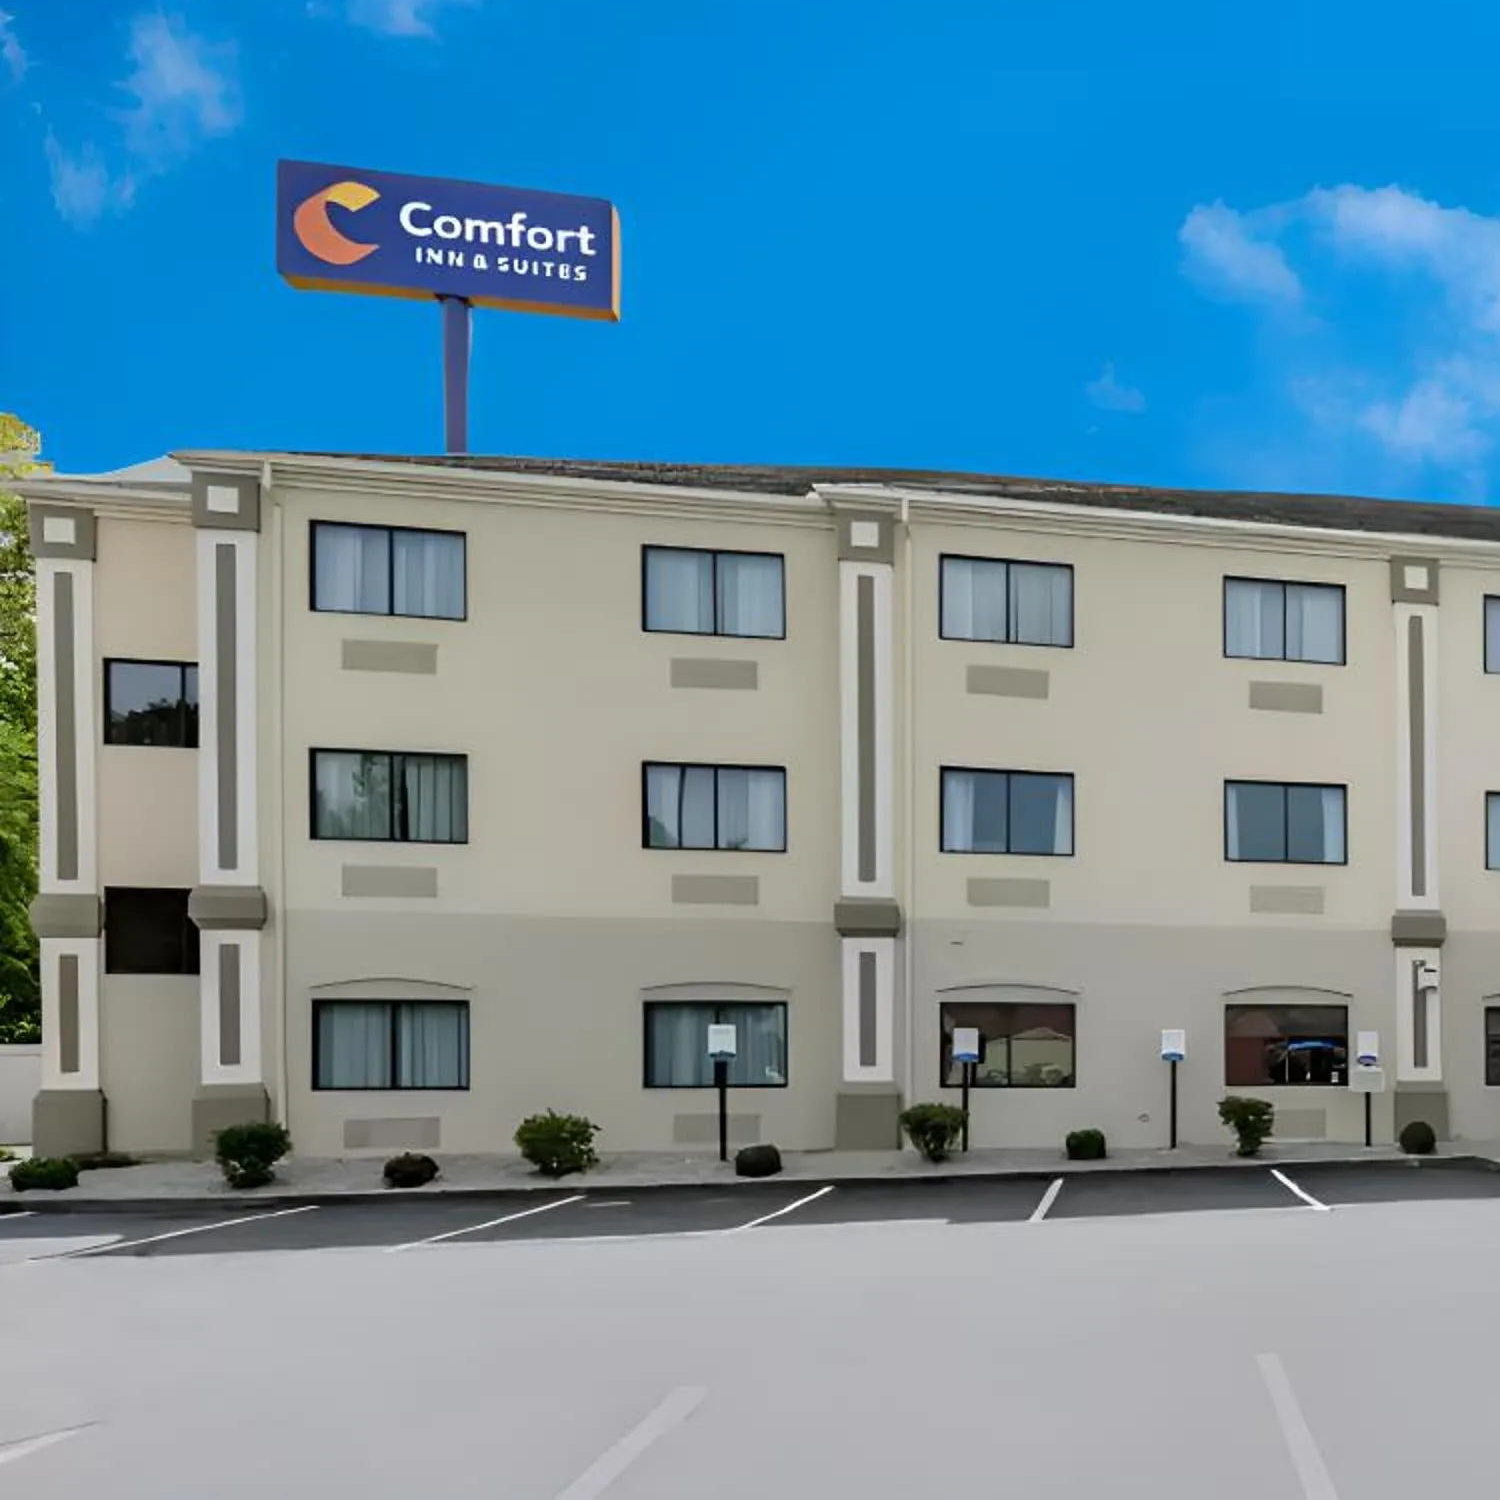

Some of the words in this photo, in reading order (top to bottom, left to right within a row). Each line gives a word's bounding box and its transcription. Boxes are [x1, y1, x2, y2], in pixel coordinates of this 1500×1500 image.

[399, 202, 596, 255] Comfort
[416, 247, 464, 267] INN
[497, 257, 588, 281] SUITES
